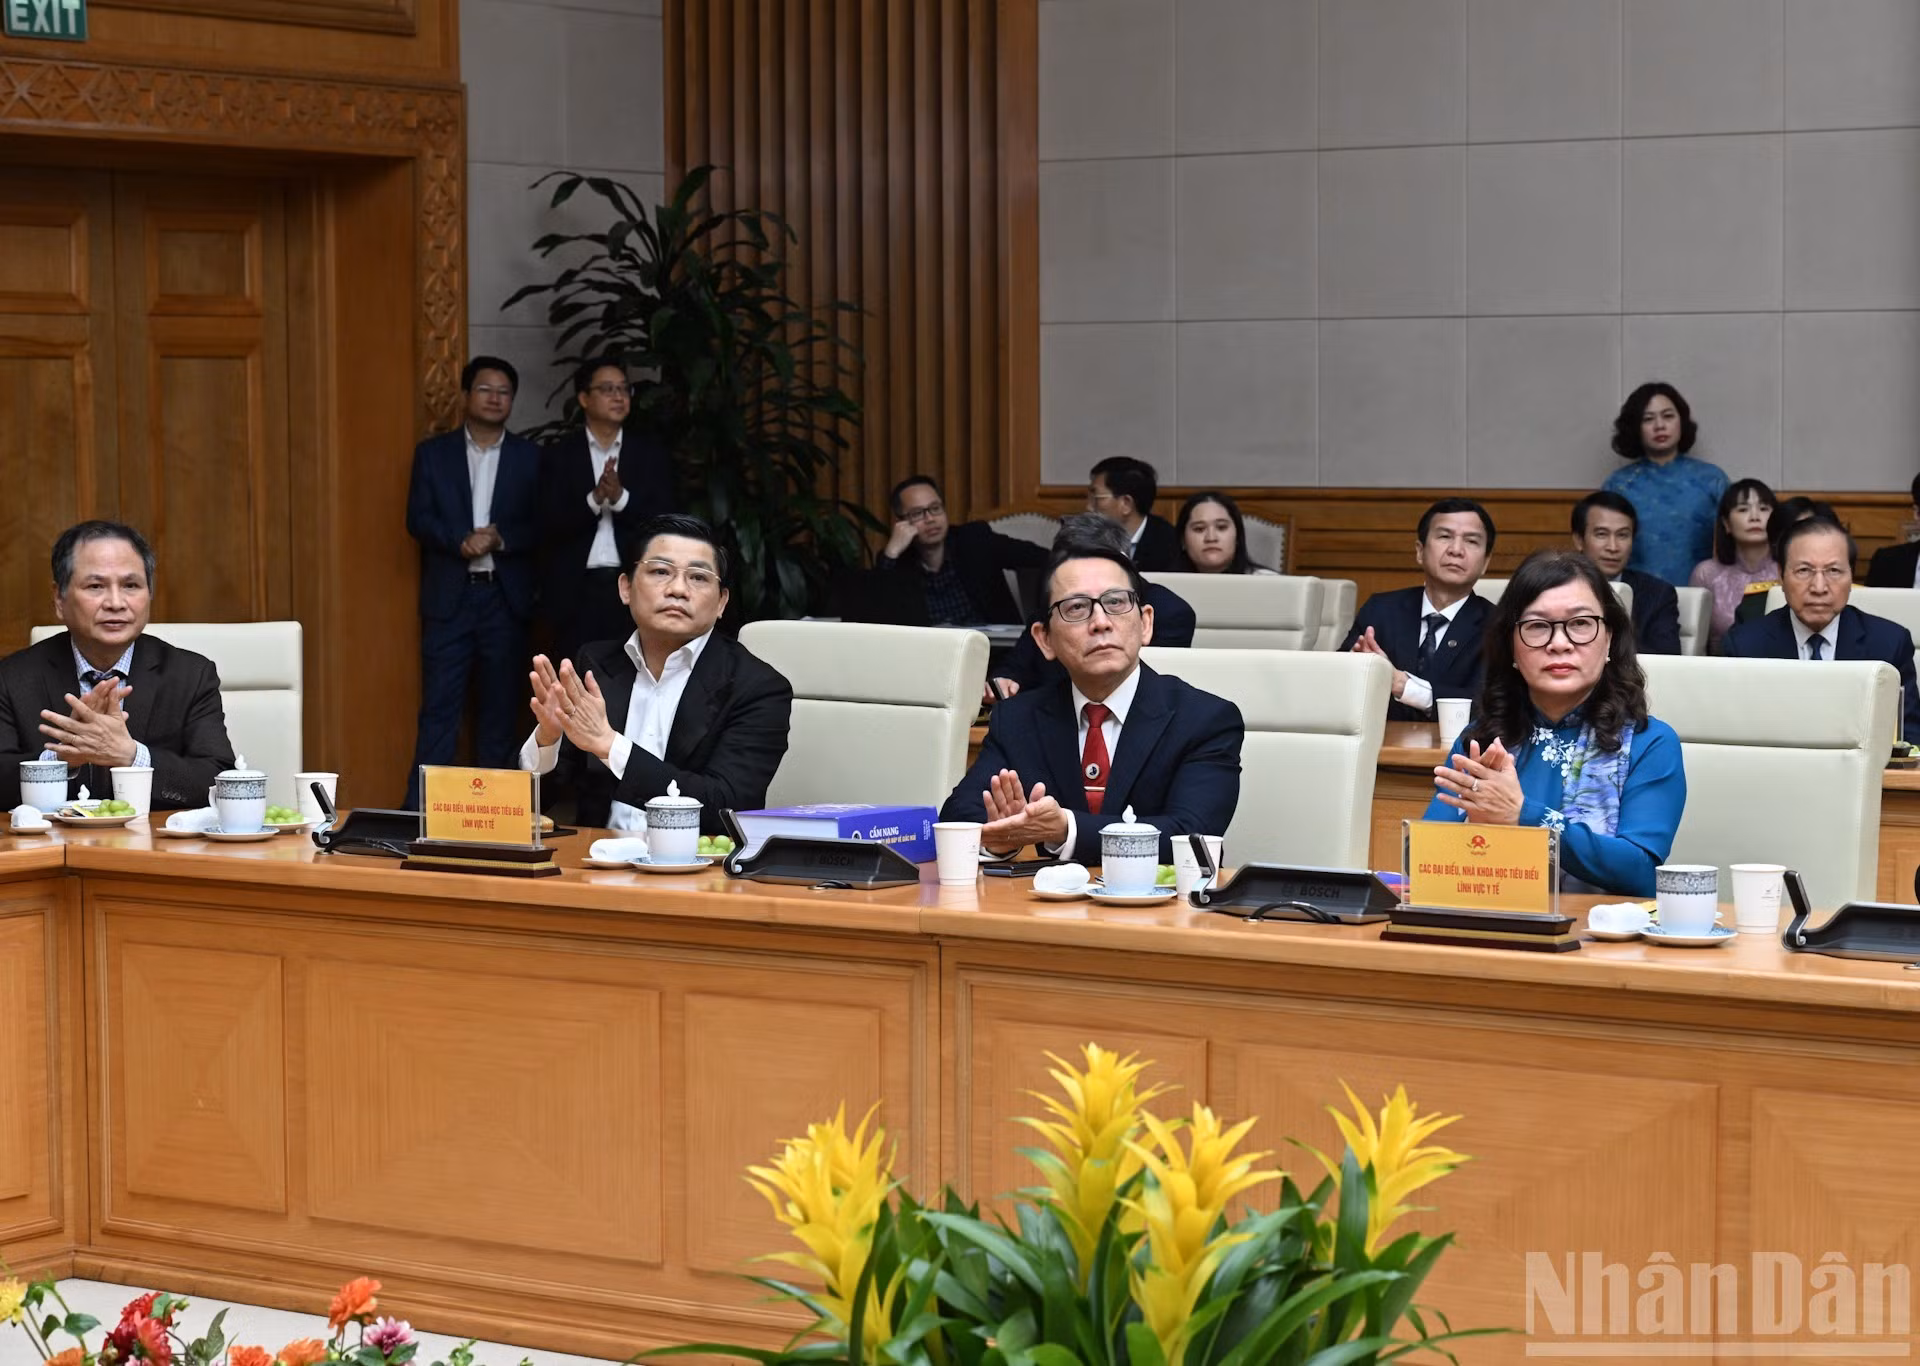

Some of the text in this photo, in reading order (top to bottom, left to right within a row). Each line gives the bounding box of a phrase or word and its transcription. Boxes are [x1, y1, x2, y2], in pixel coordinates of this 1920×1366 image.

[10, 0, 81, 34] EXIT
[882, 826, 899, 837] NANG
[1462, 864, 1475, 876] NHÀ
[1477, 866, 1494, 877] KHOA
[1495, 867, 1508, 880] HỌC
[1299, 885, 1341, 898] BOSCH
[1486, 883, 1491, 894] Y
[1492, 881, 1500, 895] TẾ
